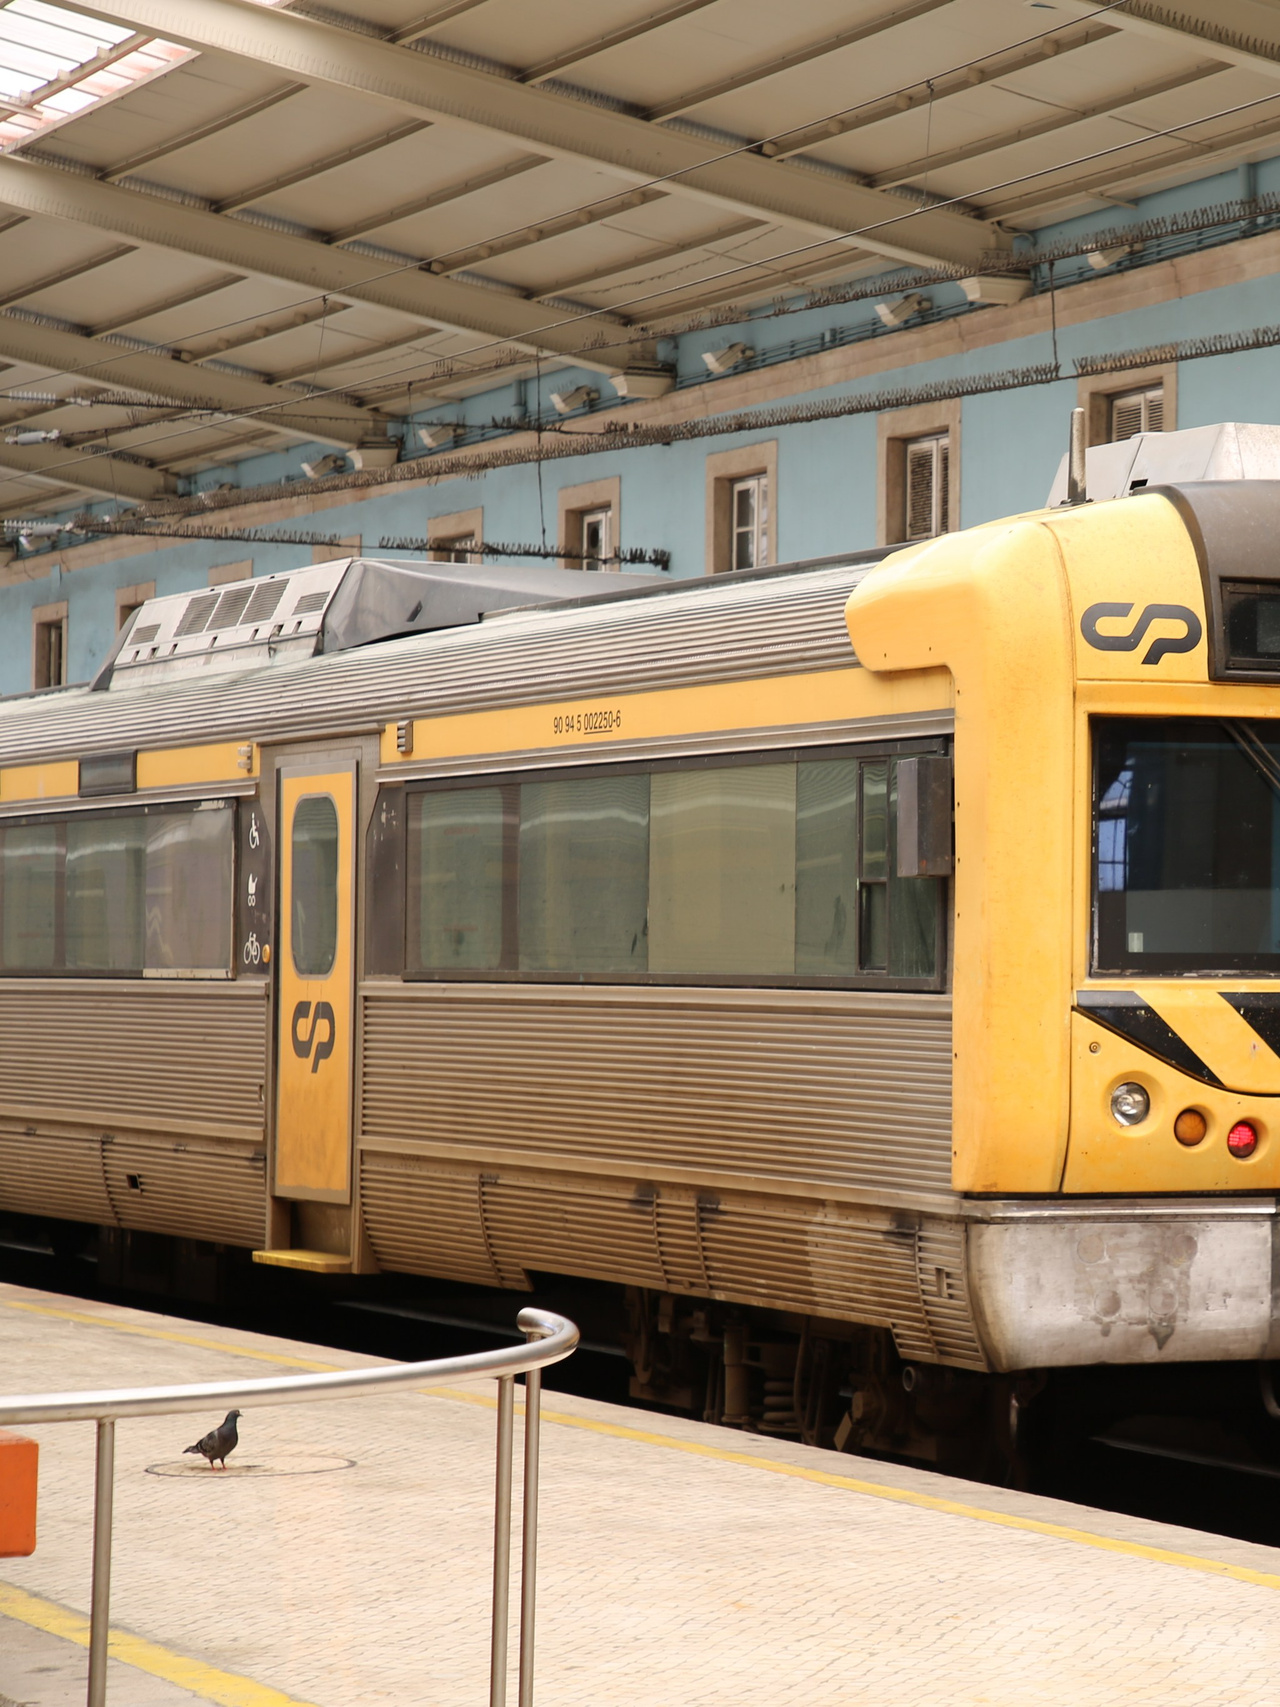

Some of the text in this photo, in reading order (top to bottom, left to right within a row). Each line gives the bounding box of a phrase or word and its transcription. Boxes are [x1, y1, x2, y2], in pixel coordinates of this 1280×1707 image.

[553, 709, 622, 734] 90 94 5 002250-6
